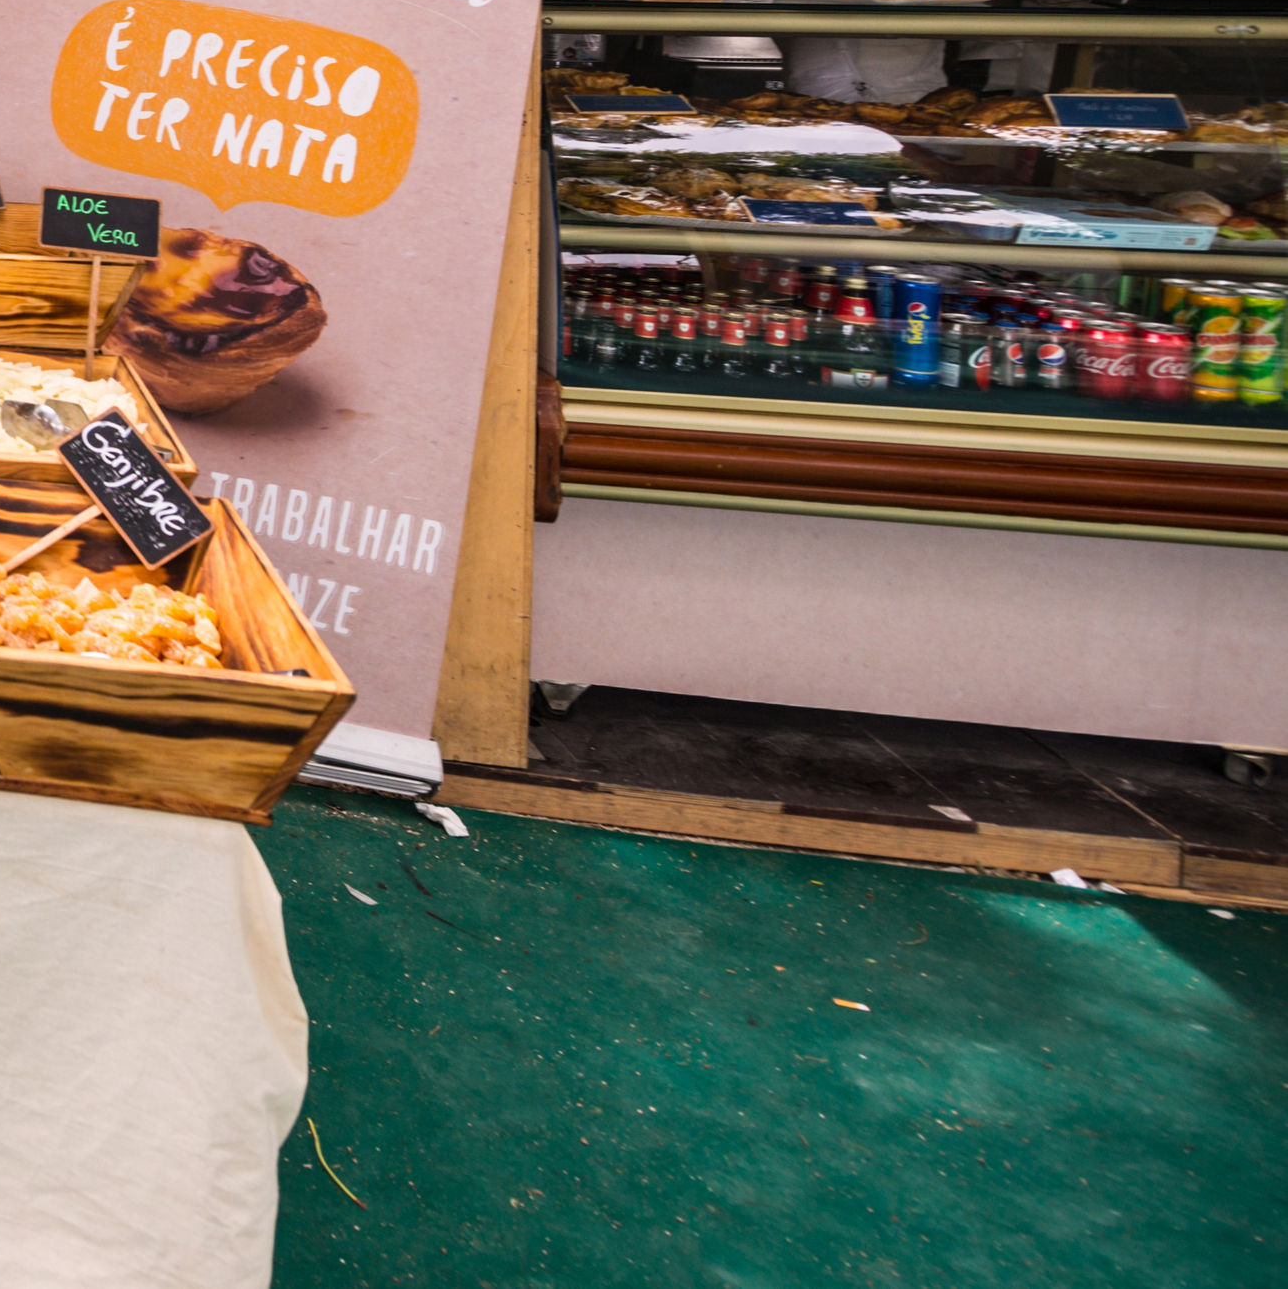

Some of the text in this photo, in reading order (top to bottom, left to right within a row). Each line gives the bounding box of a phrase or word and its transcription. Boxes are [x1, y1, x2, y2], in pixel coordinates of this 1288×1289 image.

[105, 6, 381, 117] É PRECISO
[92, 79, 358, 184] TER NATA
[210, 470, 445, 575] TRABALHAR
